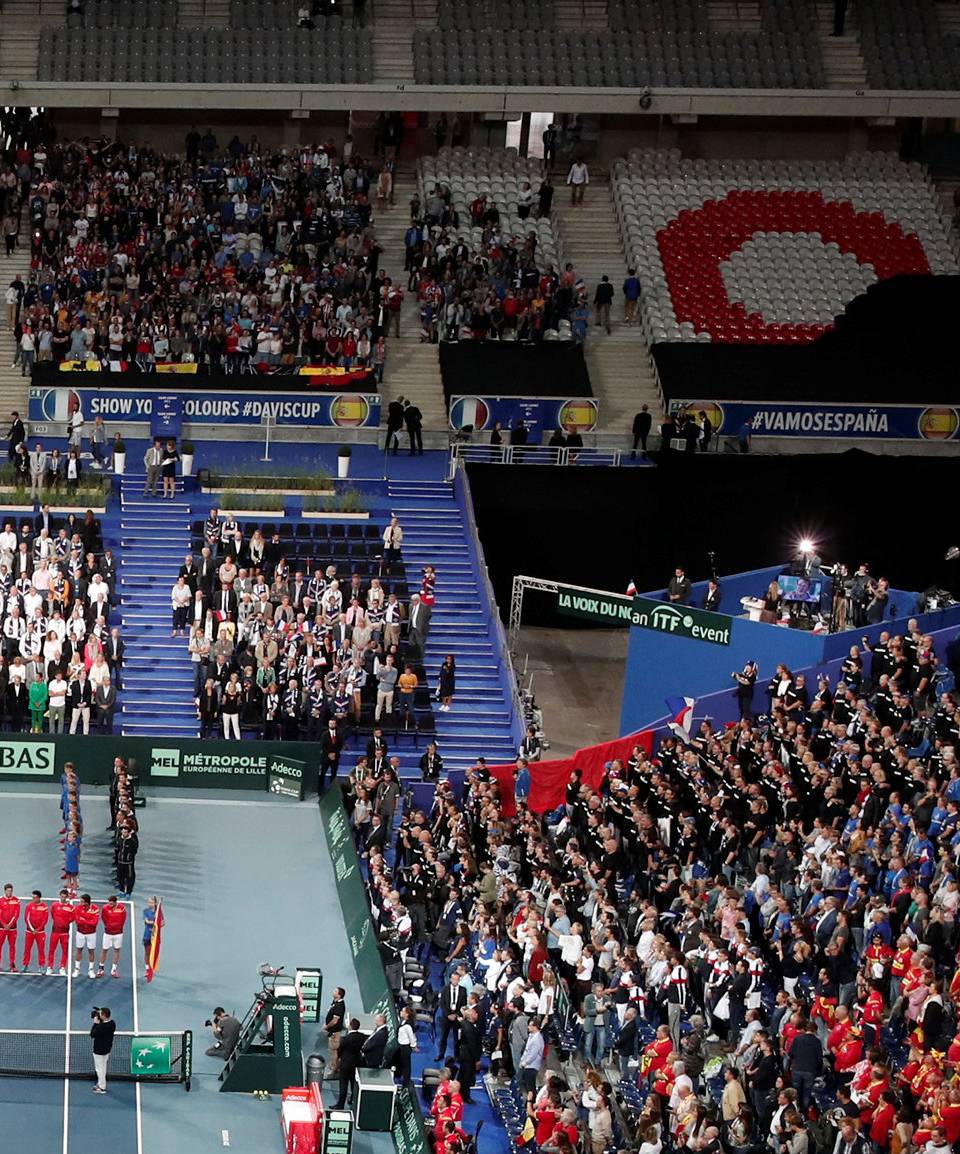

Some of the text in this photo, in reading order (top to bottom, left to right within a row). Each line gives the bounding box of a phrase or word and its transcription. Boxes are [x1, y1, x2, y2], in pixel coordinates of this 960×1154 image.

[91, 398, 132, 414] SHOW
[242, 402, 321, 419] #DAVISCUP
[751, 408, 889, 432] #VAMOSESPAÑA
[558, 592, 572, 608] LA
[632, 612, 730, 644] an ITF event
[183, 752, 267, 768] MÉTROPOLE
[270, 761, 303, 778] Adecco
[300, 980, 320, 989] MEL
[272, 1003, 298, 1012] Adecco
[282, 1016, 292, 1059] adecco.com
[328, 1125, 350, 1135] MEL
